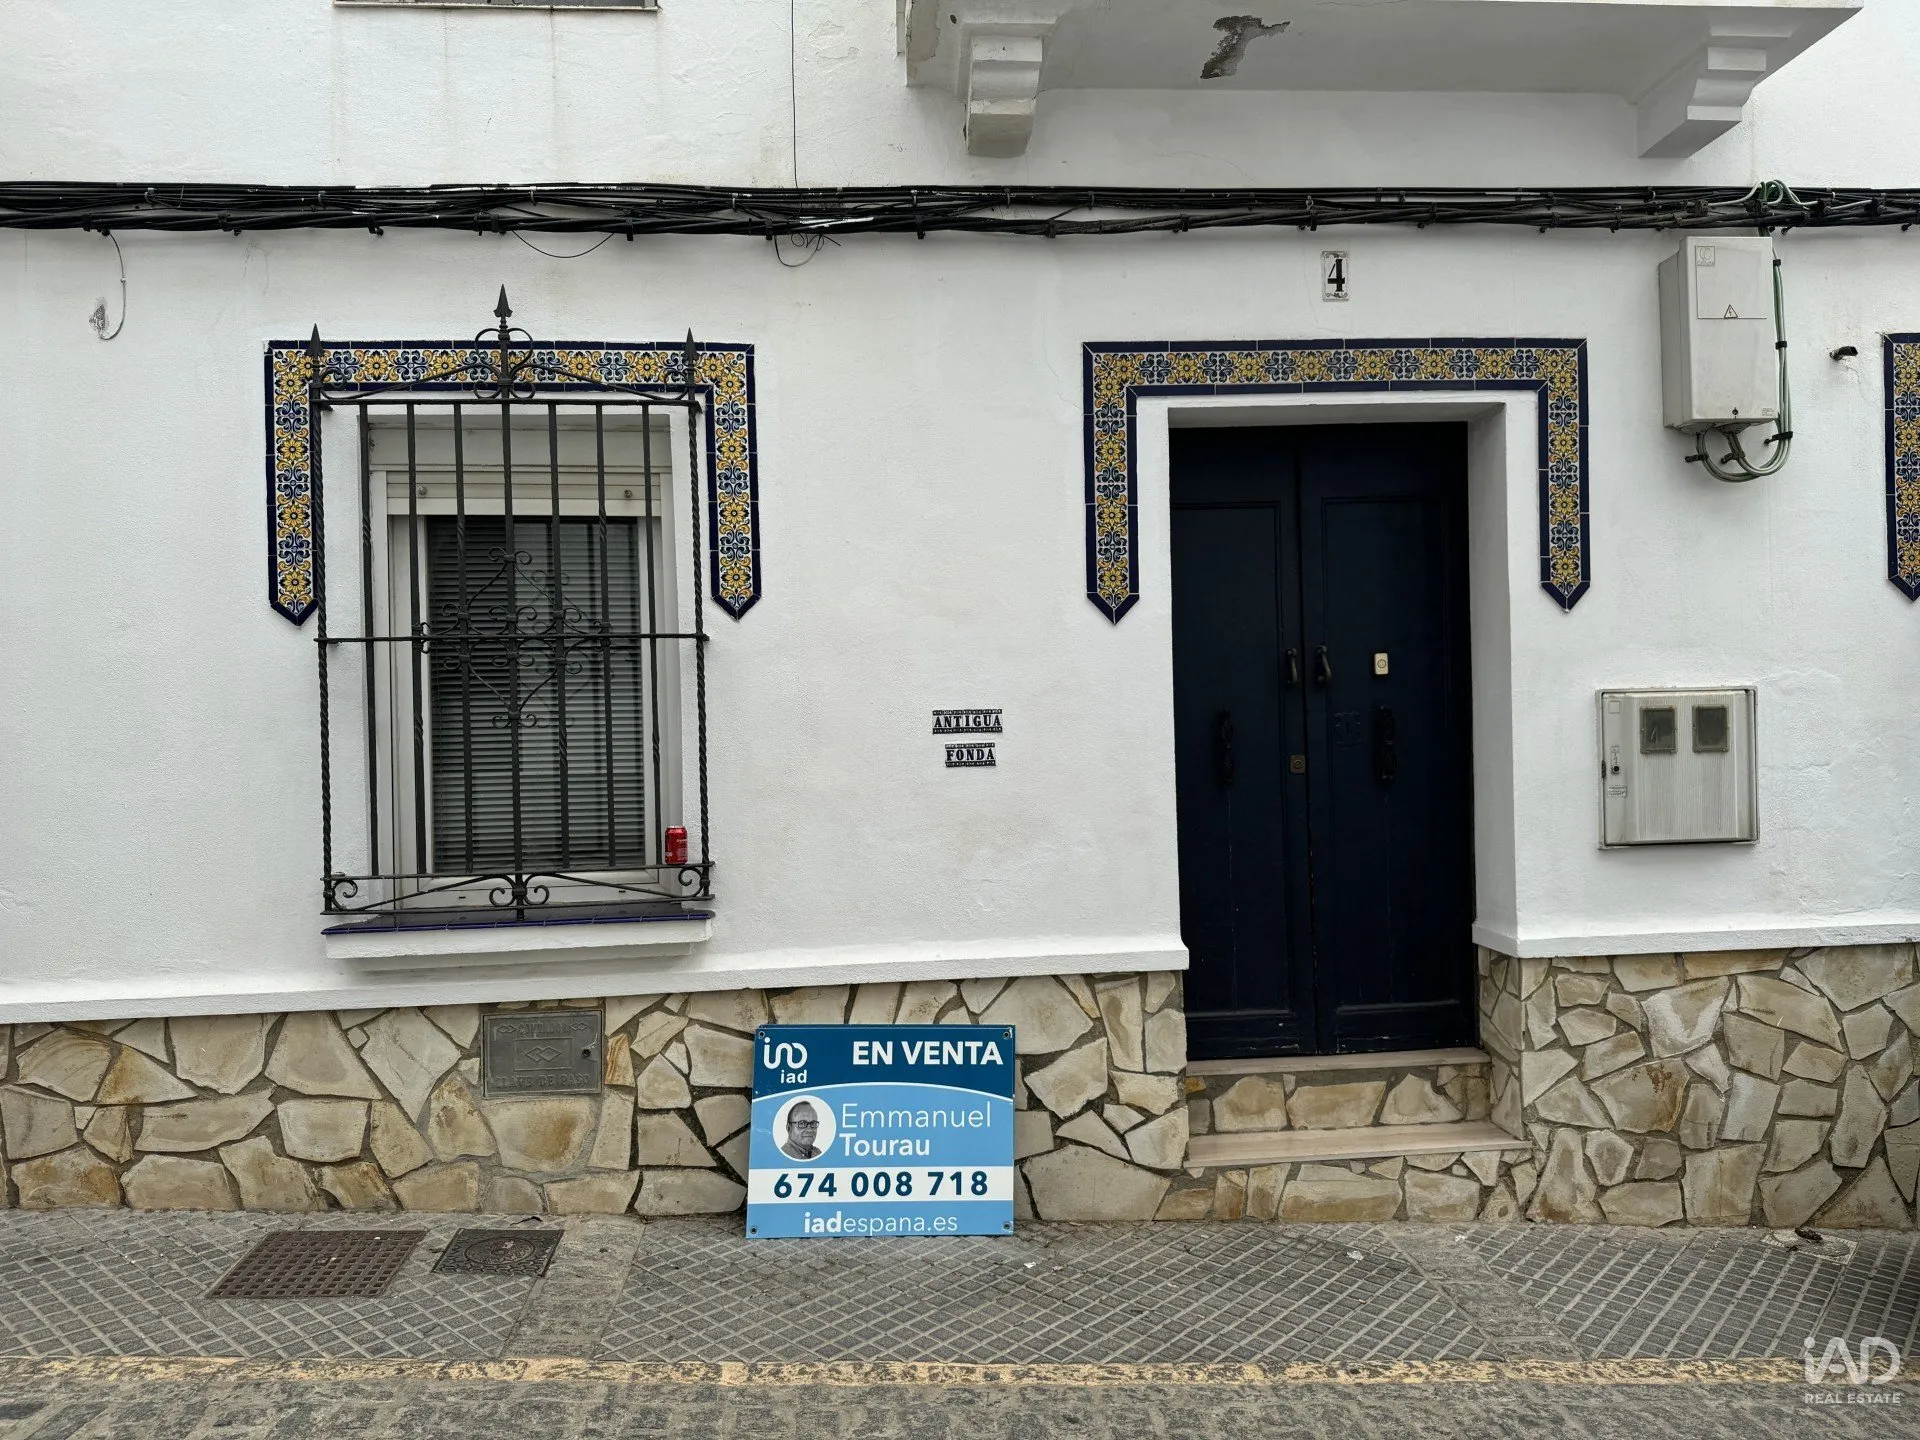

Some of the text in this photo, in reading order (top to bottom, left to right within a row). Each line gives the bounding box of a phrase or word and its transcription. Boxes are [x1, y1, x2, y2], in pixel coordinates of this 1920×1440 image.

[1327, 259, 1346, 292] 4
[934, 714, 1001, 728] ANTIGUA
[946, 748, 995, 761] FONDA
[852, 1041, 1004, 1065] EN VENTA
[780, 1070, 807, 1084] iad
[842, 1101, 991, 1128] Emmanuel
[839, 1133, 930, 1156] Tourau
[773, 1171, 988, 1198] 674 008 718
[804, 1211, 958, 1235] iadespana.es
